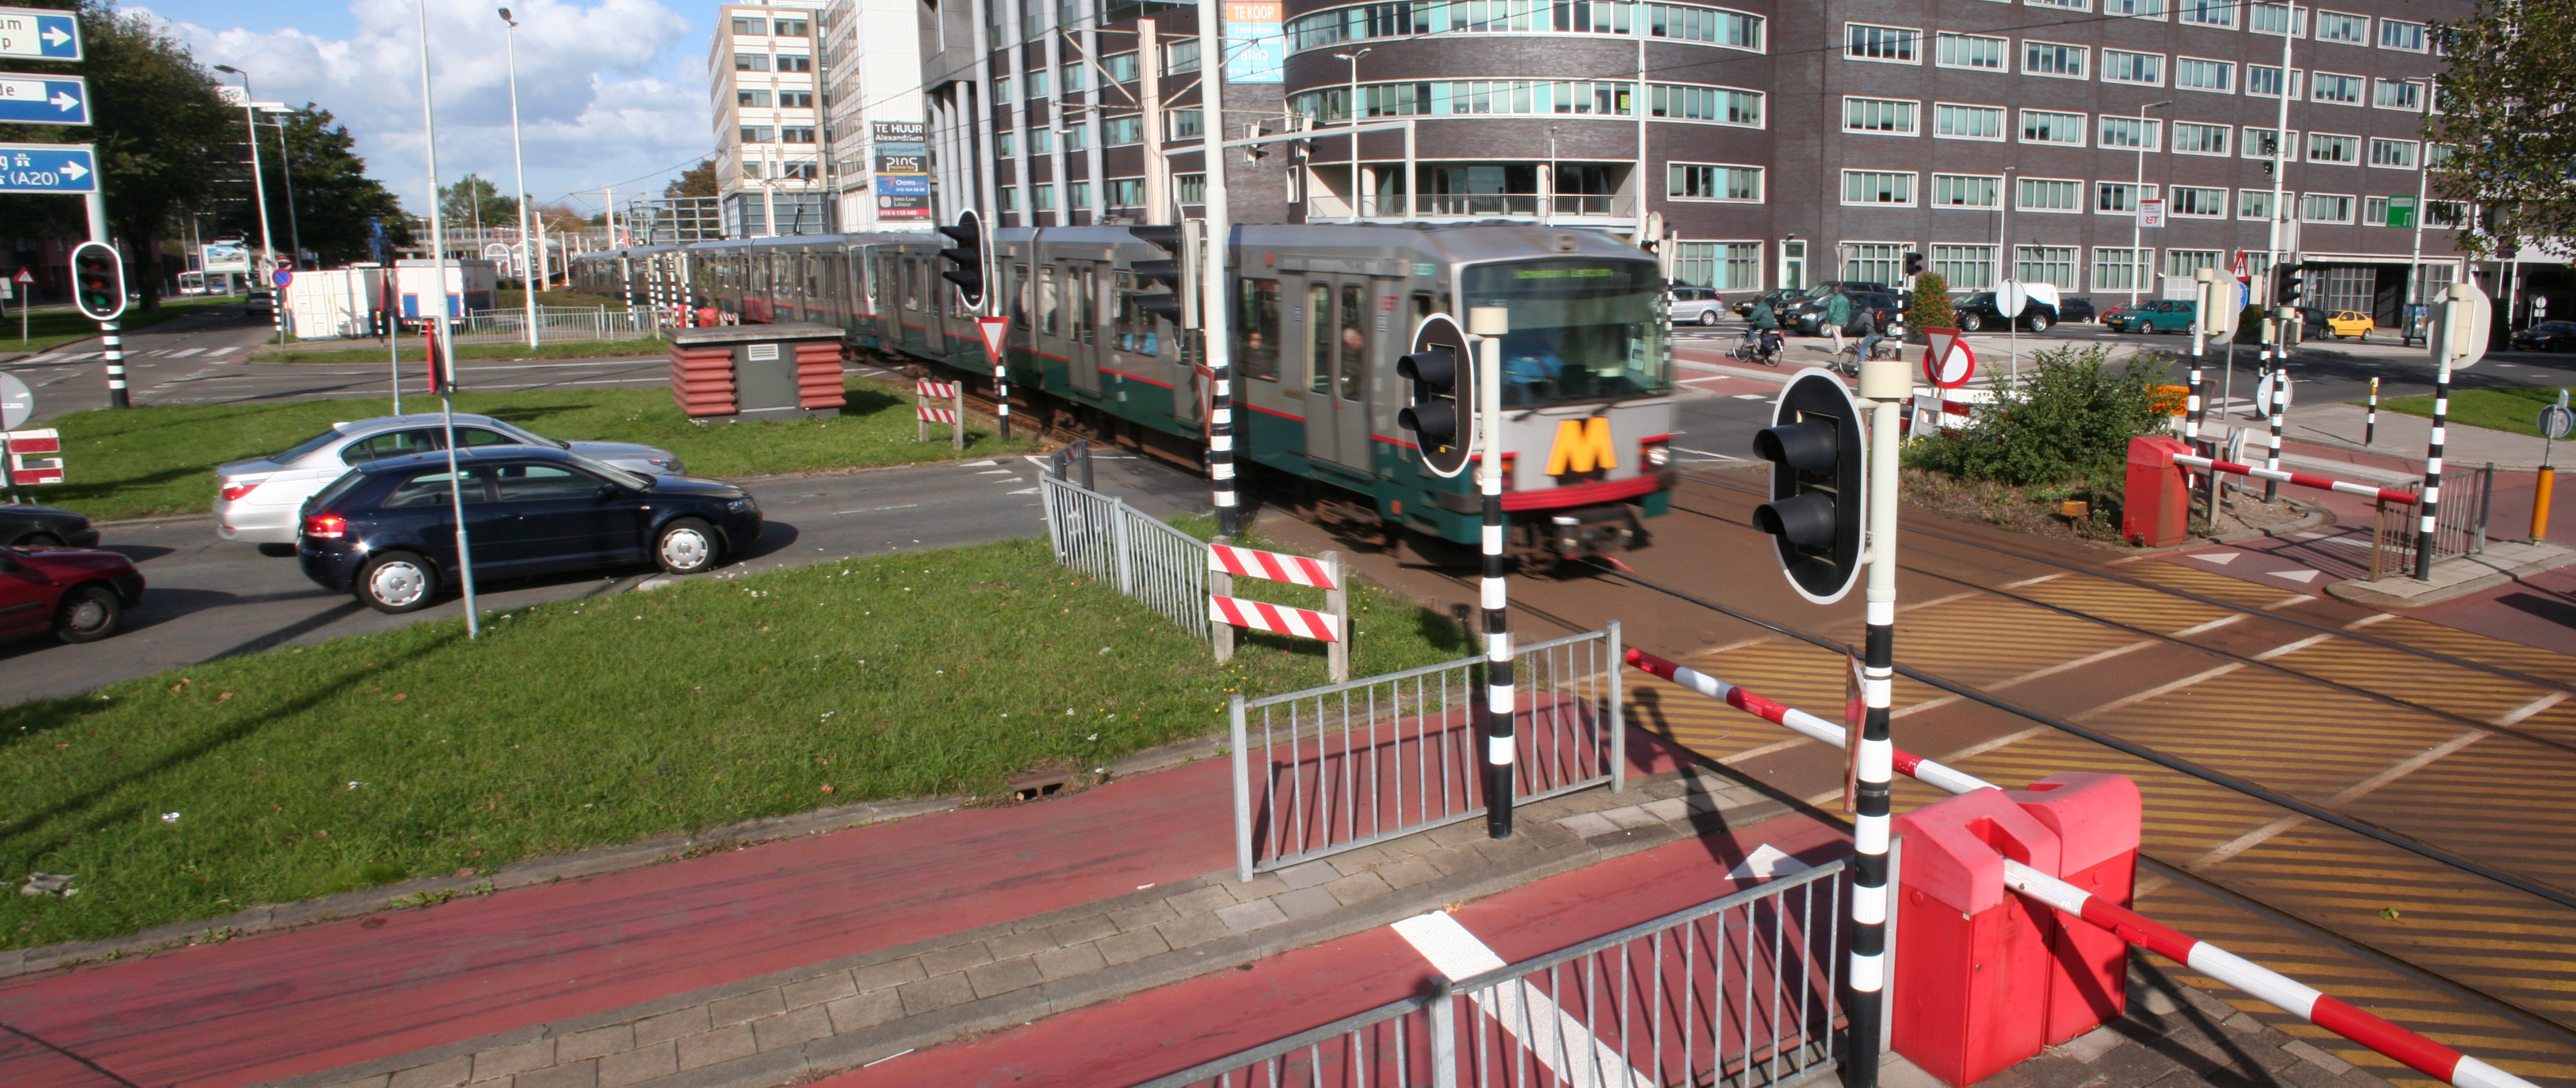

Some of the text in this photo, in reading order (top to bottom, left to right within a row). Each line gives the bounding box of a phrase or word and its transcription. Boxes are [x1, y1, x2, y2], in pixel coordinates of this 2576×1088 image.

[1233, 6, 1274, 19] TE KOOP
[0, 19, 22, 30] m
[874, 124, 922, 133] TE HUUR
[10, 171, 60, 186] (A20)
[1544, 417, 1618, 476] M
